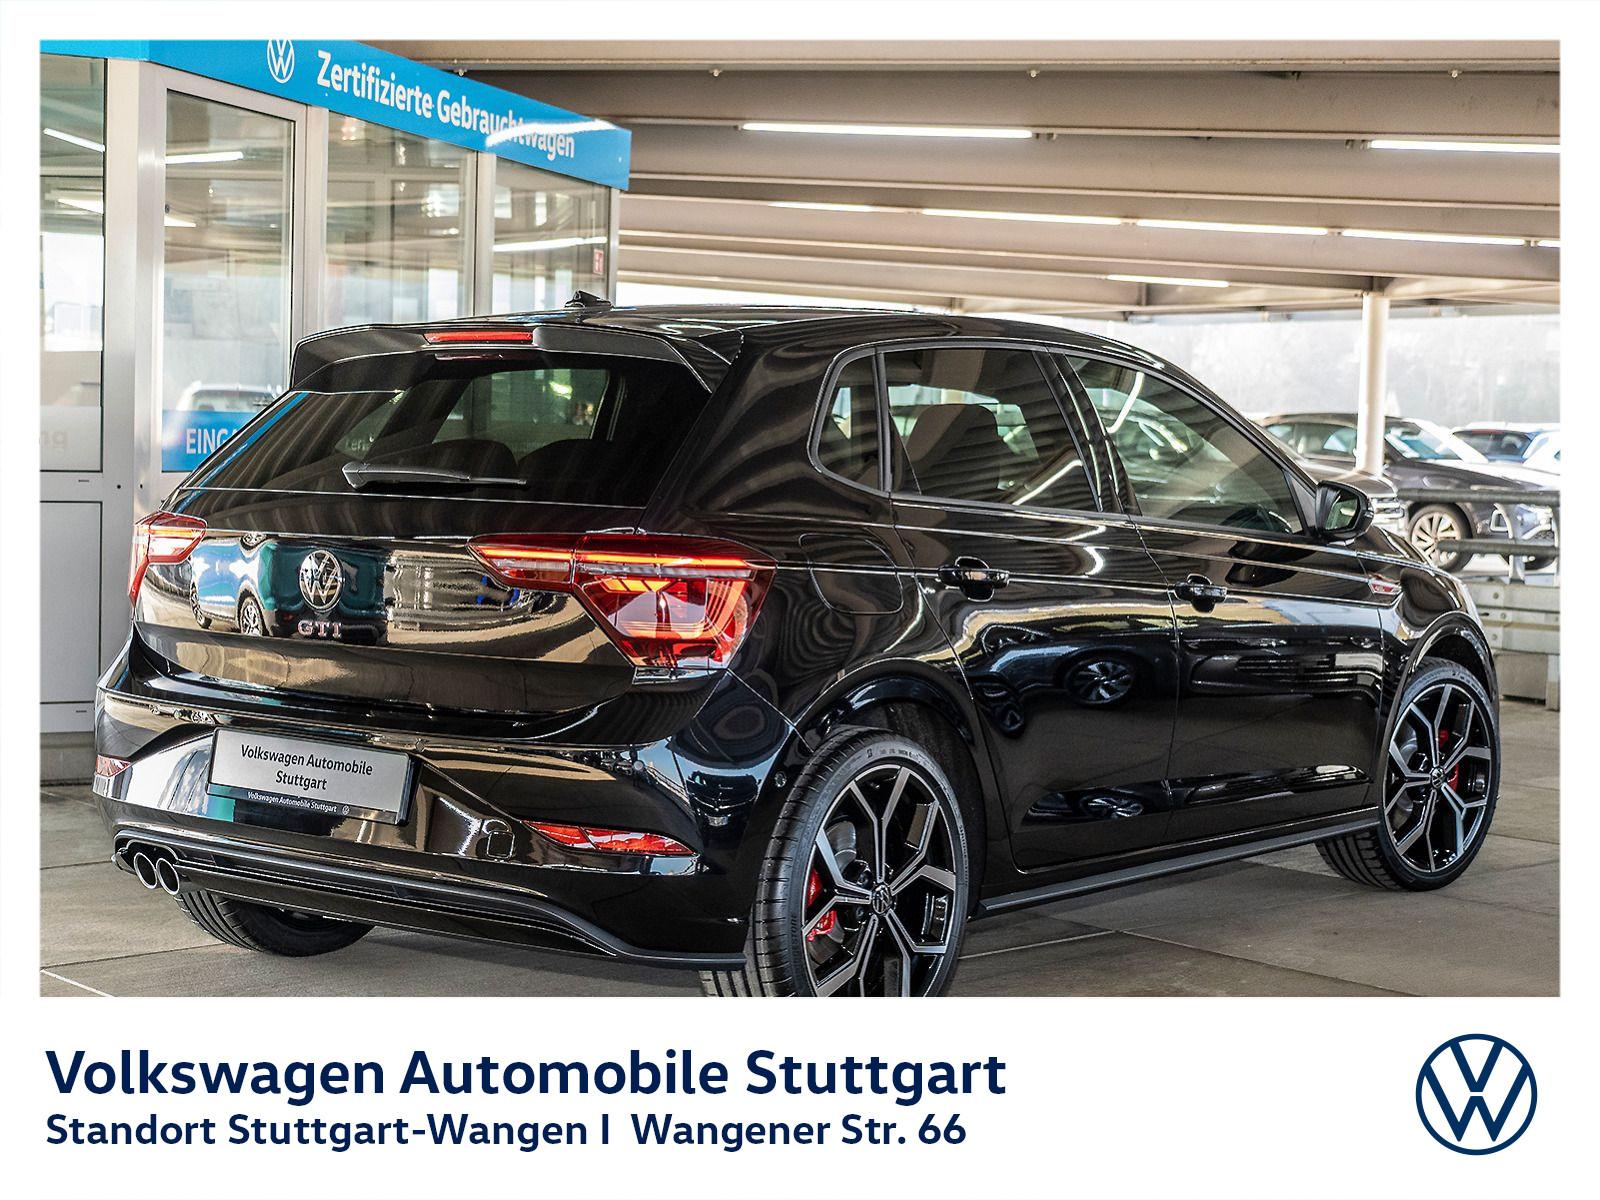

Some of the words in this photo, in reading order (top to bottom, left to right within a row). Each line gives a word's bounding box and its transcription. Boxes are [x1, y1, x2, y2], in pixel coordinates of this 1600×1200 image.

[317, 49, 433, 119] Zertifizierte
[186, 428, 239, 455] EING
[298, 620, 342, 638] GTI
[241, 744, 305, 767] Volkswagen
[305, 753, 373, 776] Automobile
[275, 770, 328, 791] Stuttgart
[247, 791, 279, 804] Volkswagen
[279, 796, 311, 808] Automobile
[310, 801, 337, 813] Stuttgart
